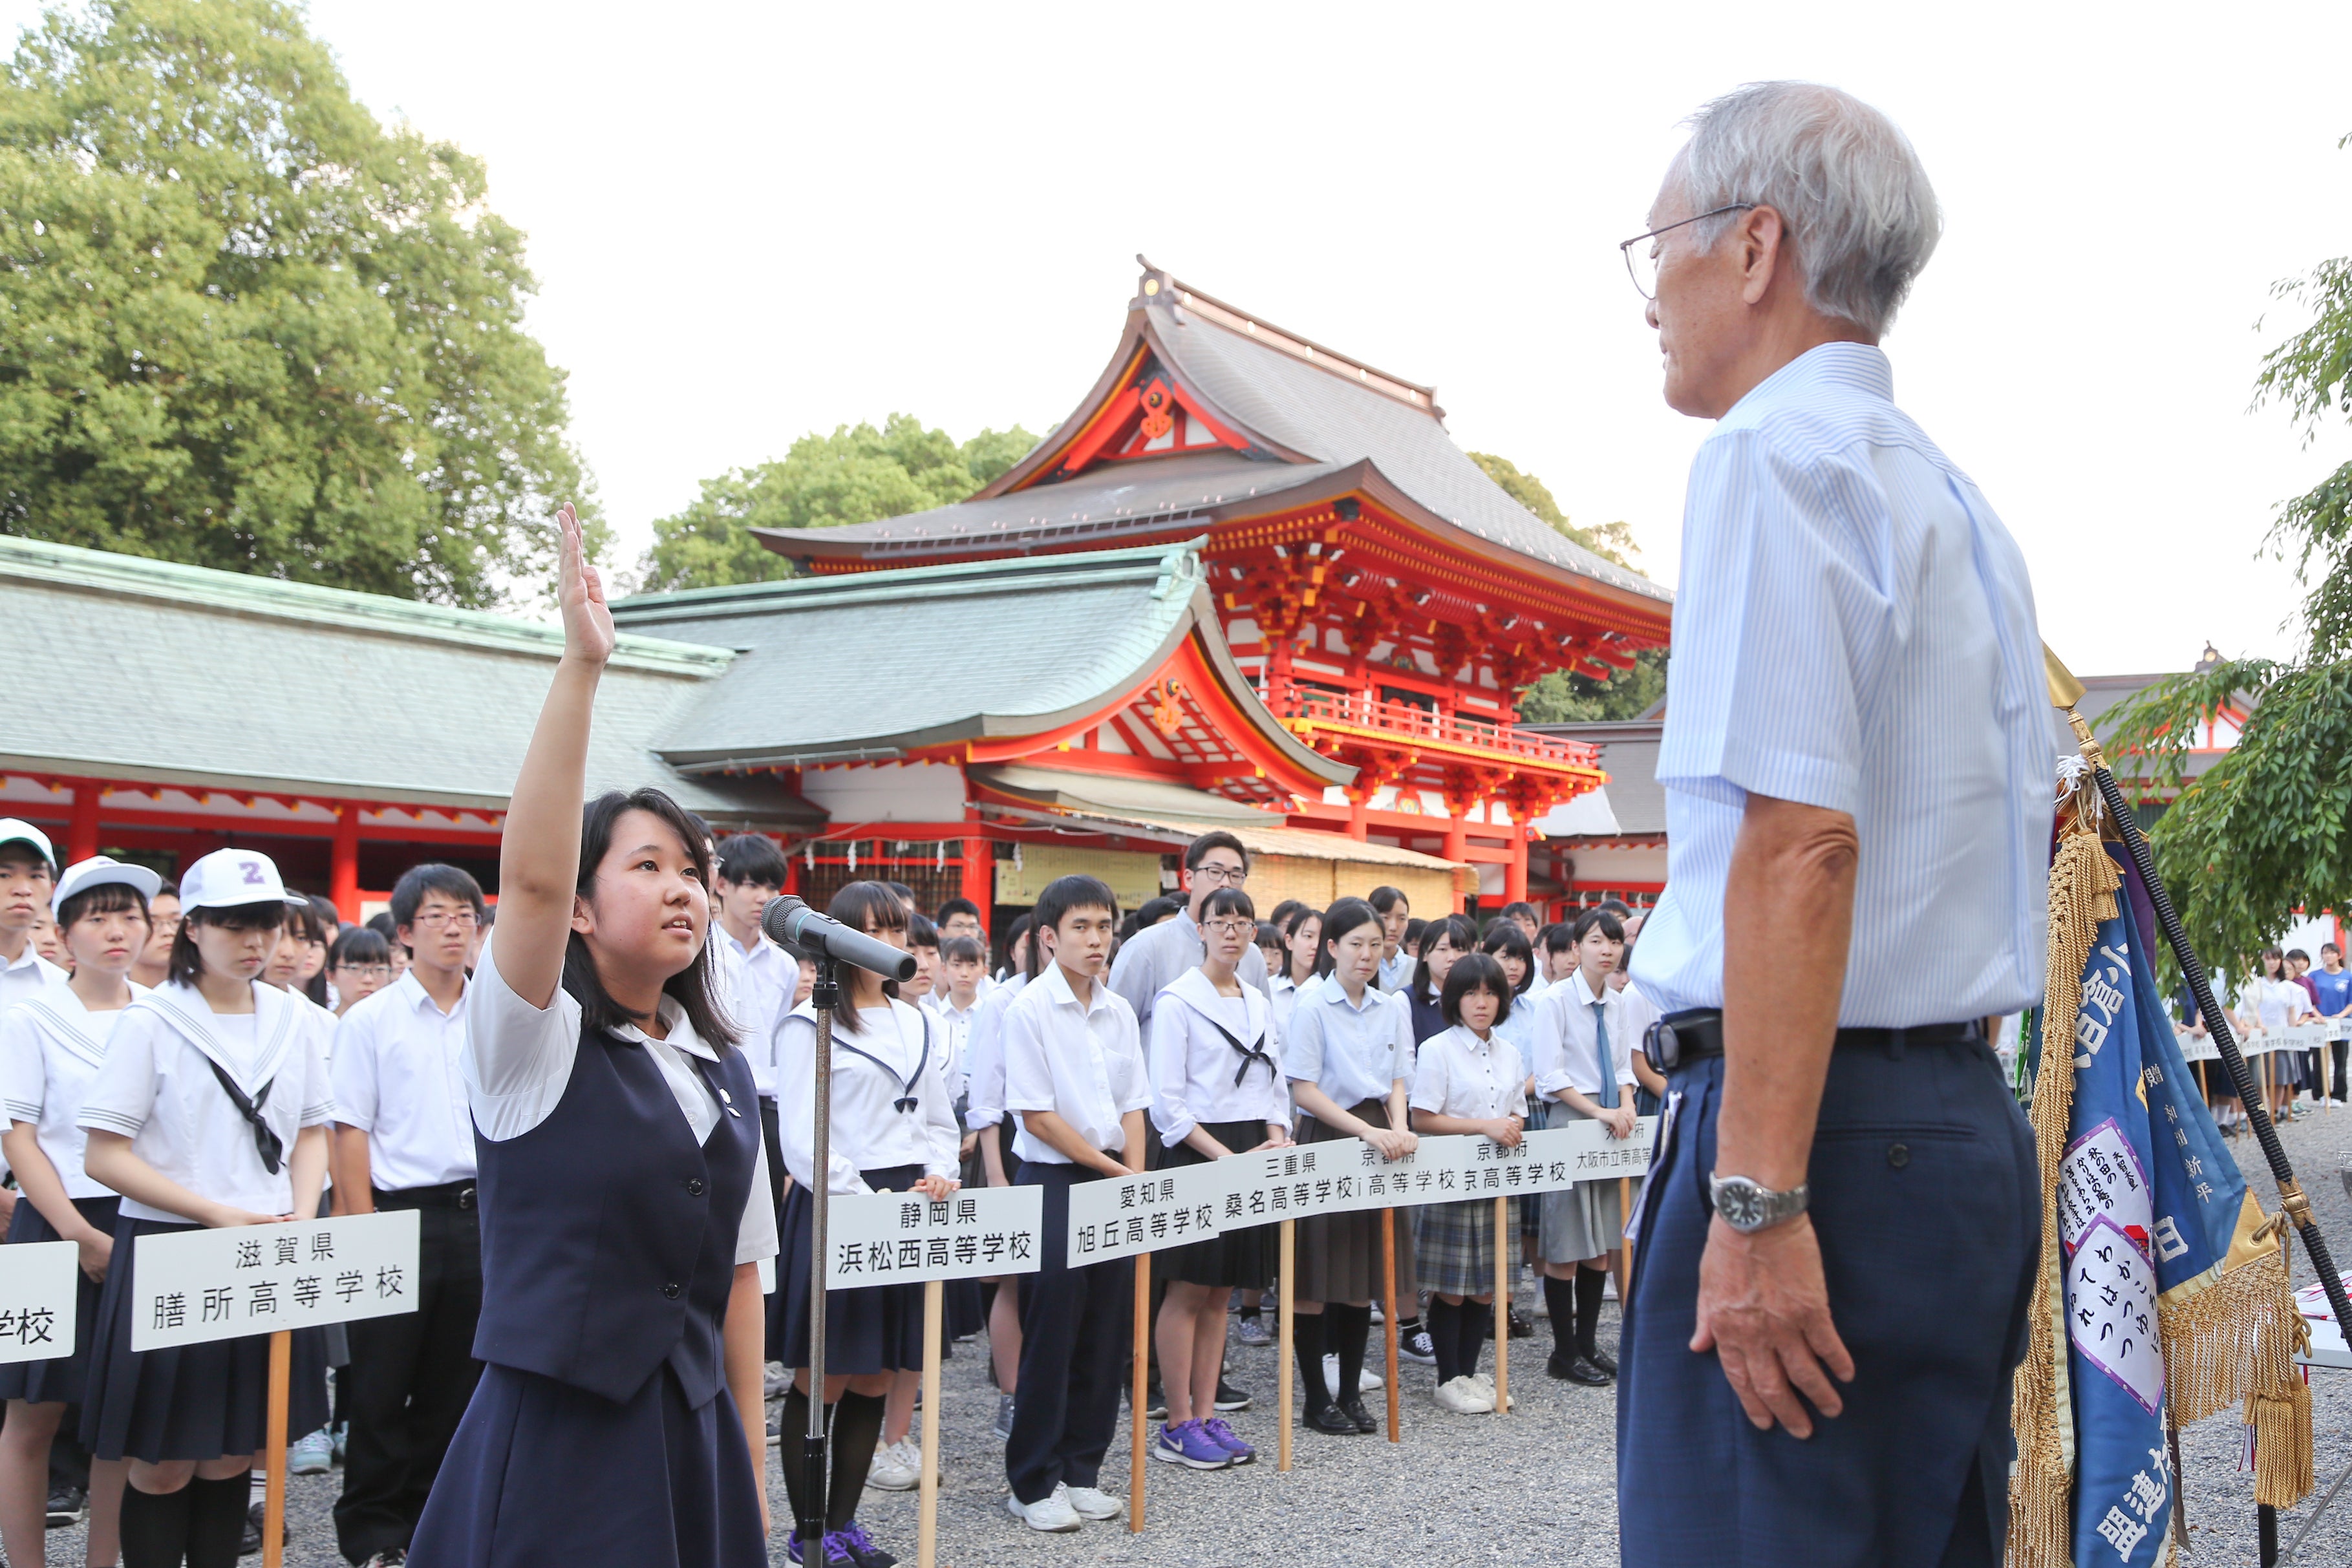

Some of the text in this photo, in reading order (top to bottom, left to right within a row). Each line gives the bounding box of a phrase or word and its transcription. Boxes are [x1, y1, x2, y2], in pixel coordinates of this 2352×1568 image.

[1265, 1152, 1316, 1178] 三重県
[1358, 1168, 1455, 1197] 高等学校
[2088, 1147, 2117, 1184] 秋の田の
[1120, 1178, 1174, 1209] 愛知県
[1226, 1175, 1352, 1218] 桑名高等学校
[901, 1199, 977, 1229] 静岡県
[1077, 1203, 1212, 1254] 旭丘高等学校
[235, 1232, 335, 1269] 滋賀県
[838, 1230, 1031, 1275] 浜松西高等学校
[153, 1264, 404, 1330] 膳所高等学校
